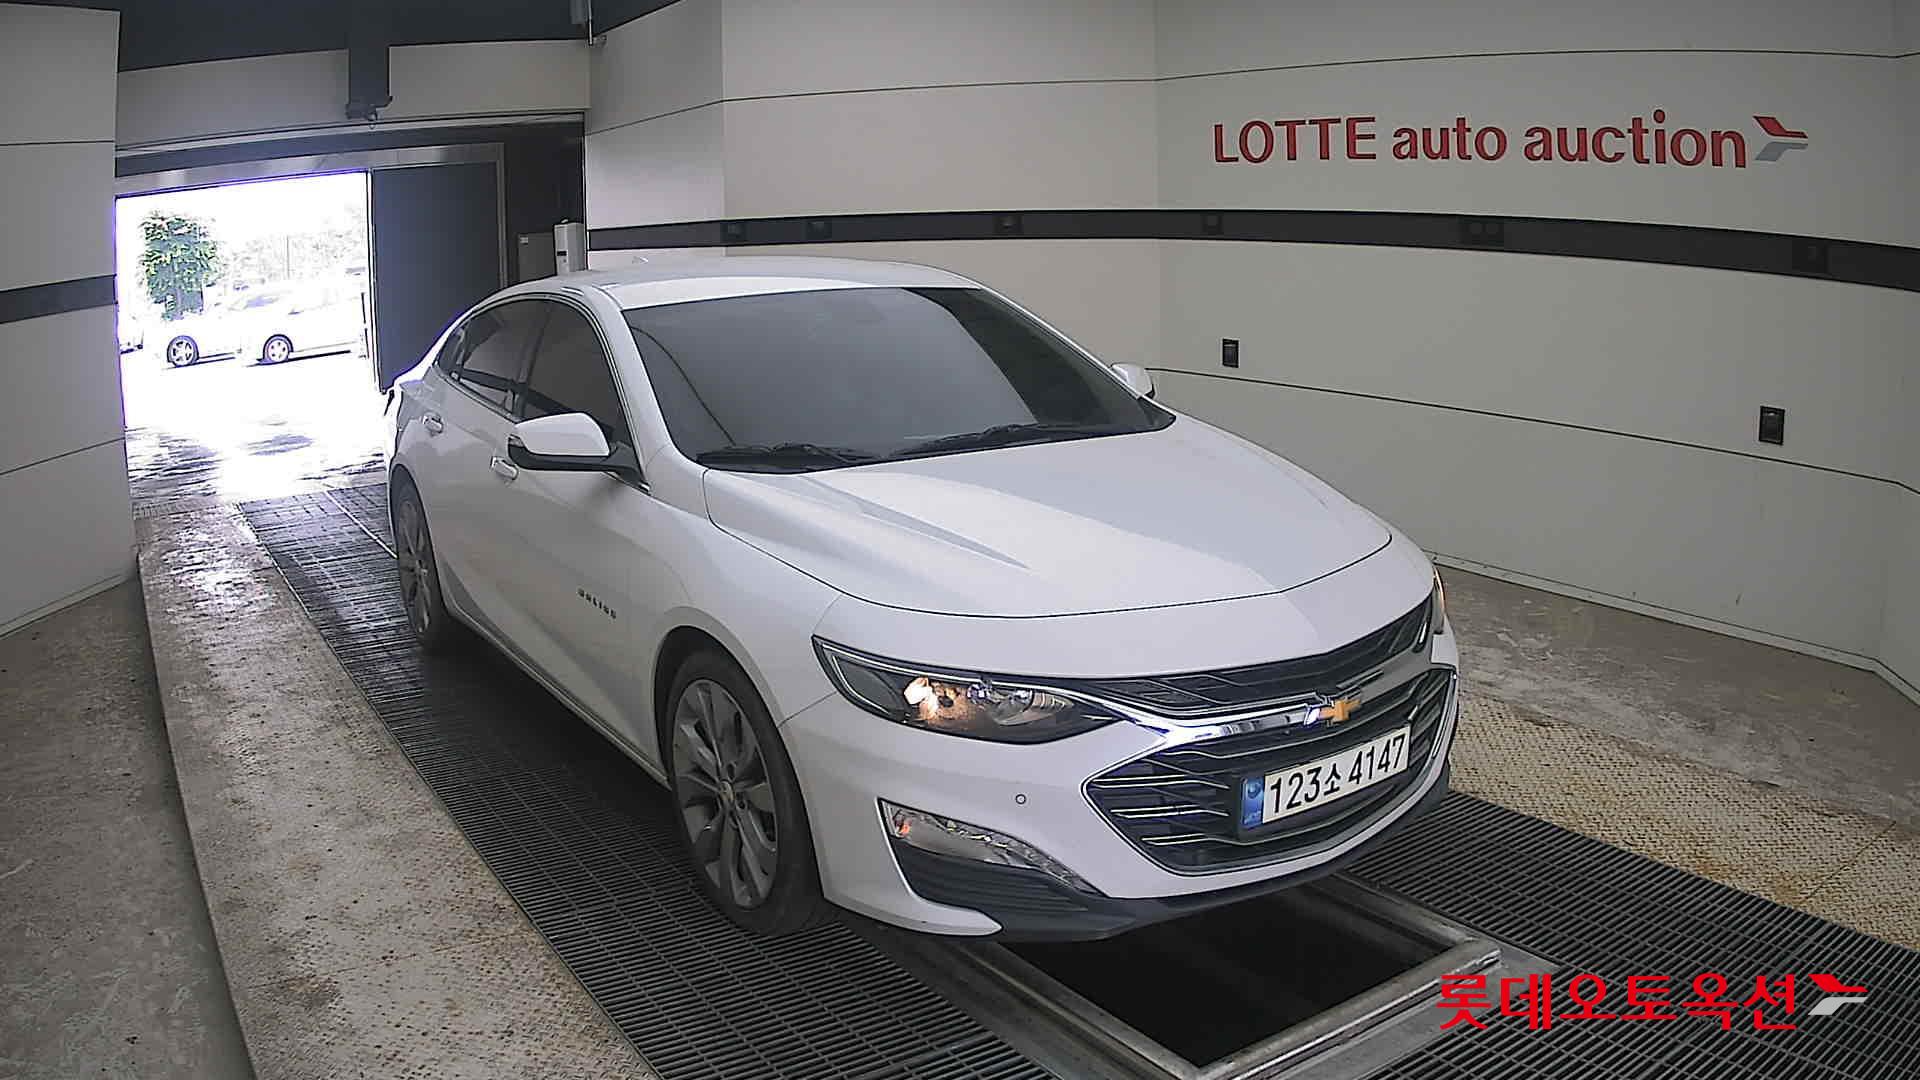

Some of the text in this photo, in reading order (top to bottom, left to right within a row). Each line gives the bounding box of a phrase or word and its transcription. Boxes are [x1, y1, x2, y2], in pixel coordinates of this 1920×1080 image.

[1213, 109, 1747, 168] LOTTE auto auction
[1270, 733, 1406, 814] 123소 4147
